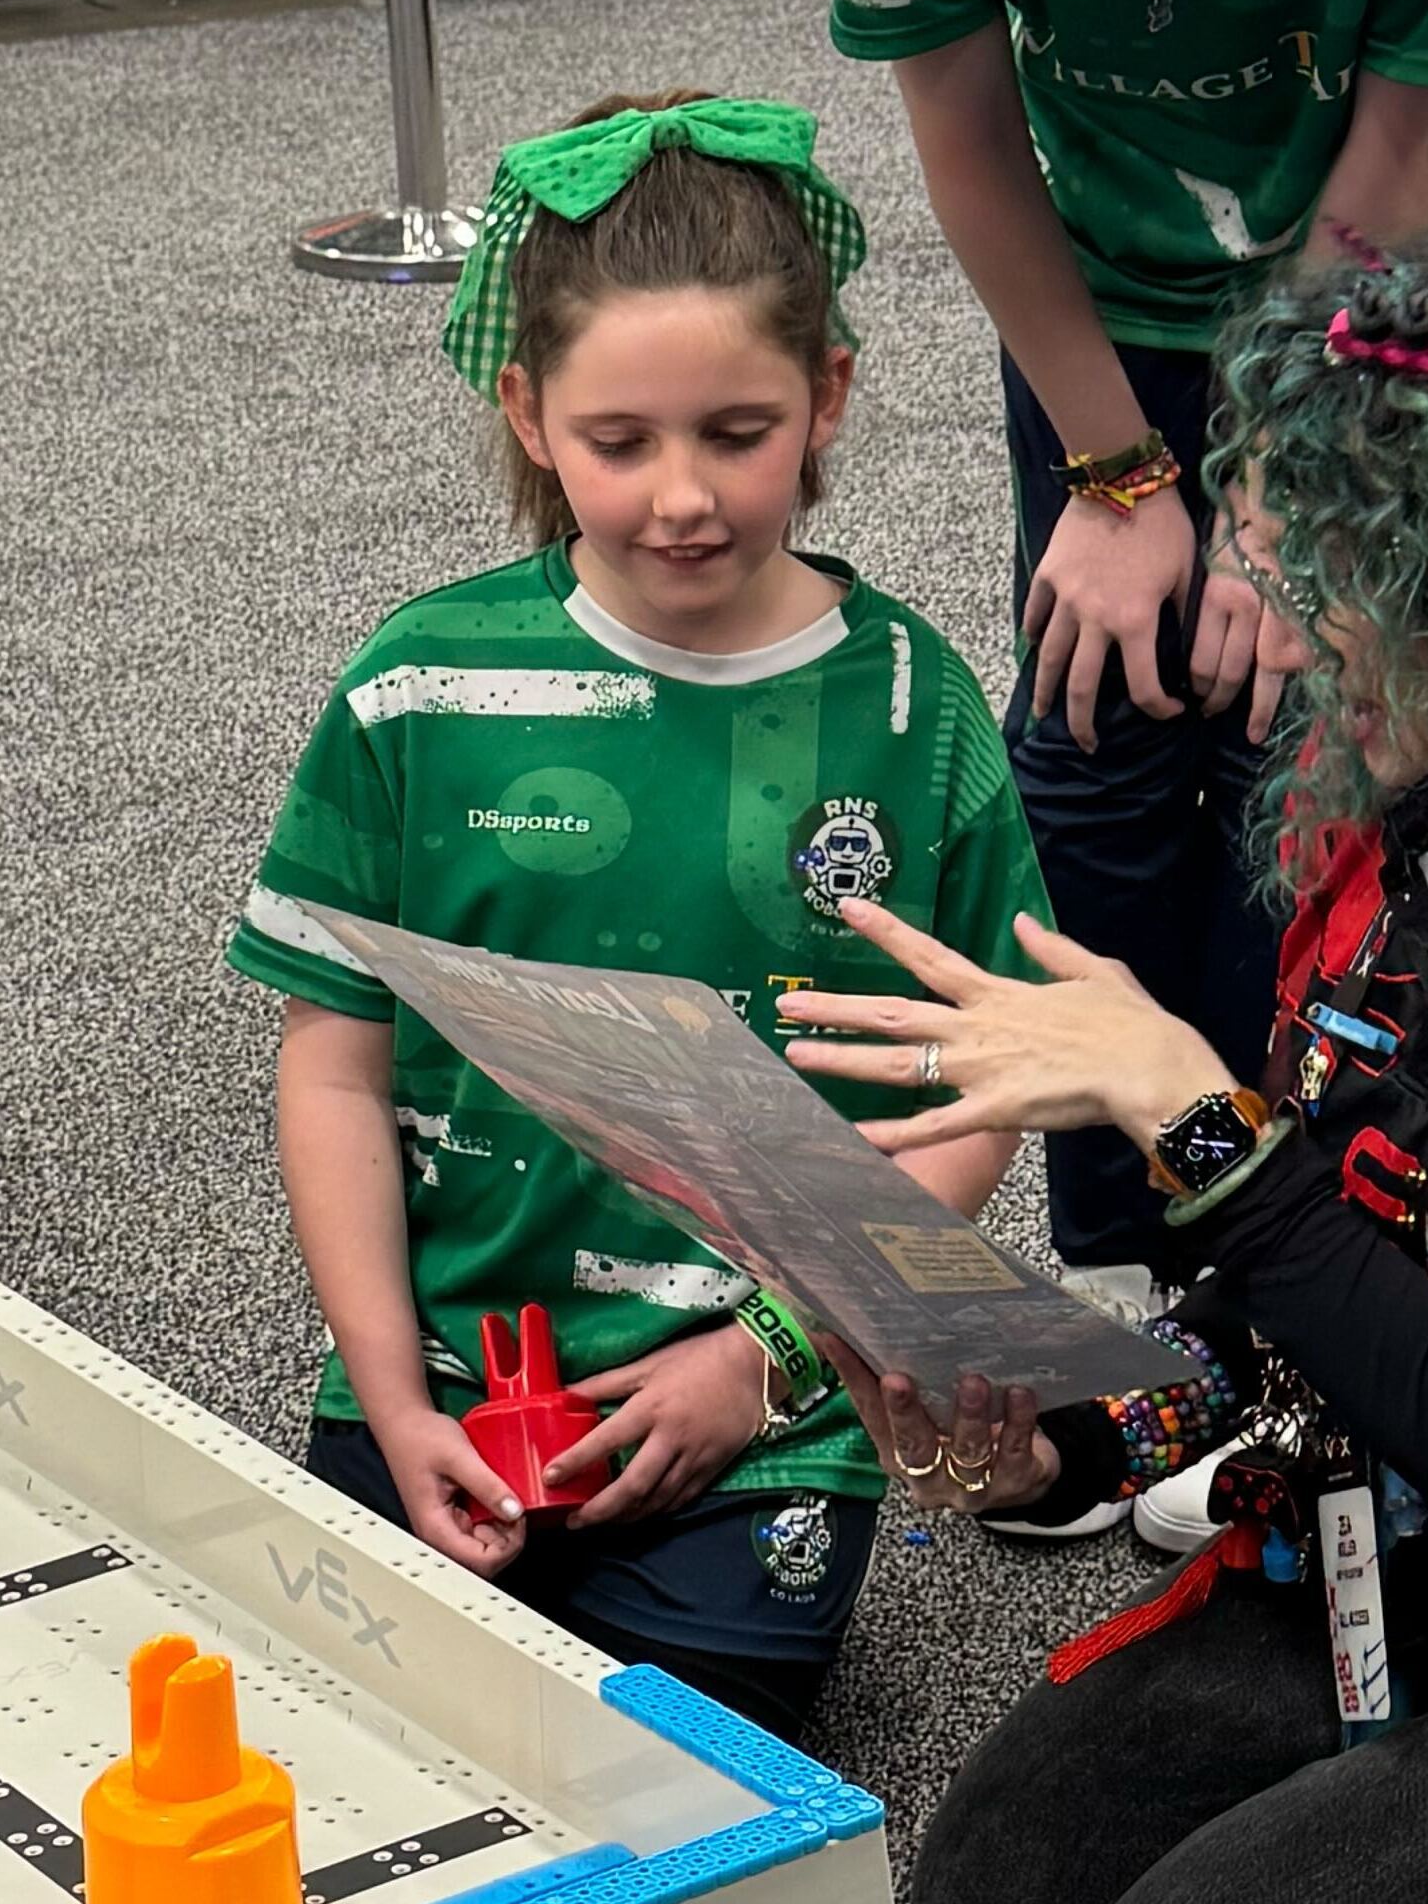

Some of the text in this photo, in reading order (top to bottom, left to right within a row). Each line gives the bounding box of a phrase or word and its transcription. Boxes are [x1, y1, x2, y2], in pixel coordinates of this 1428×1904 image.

[1022, 25, 1273, 101] VILLAGE
[467, 809, 591, 834] DSsports
[824, 796, 879, 820] RNS
[266, 1540, 402, 1669] VEX
